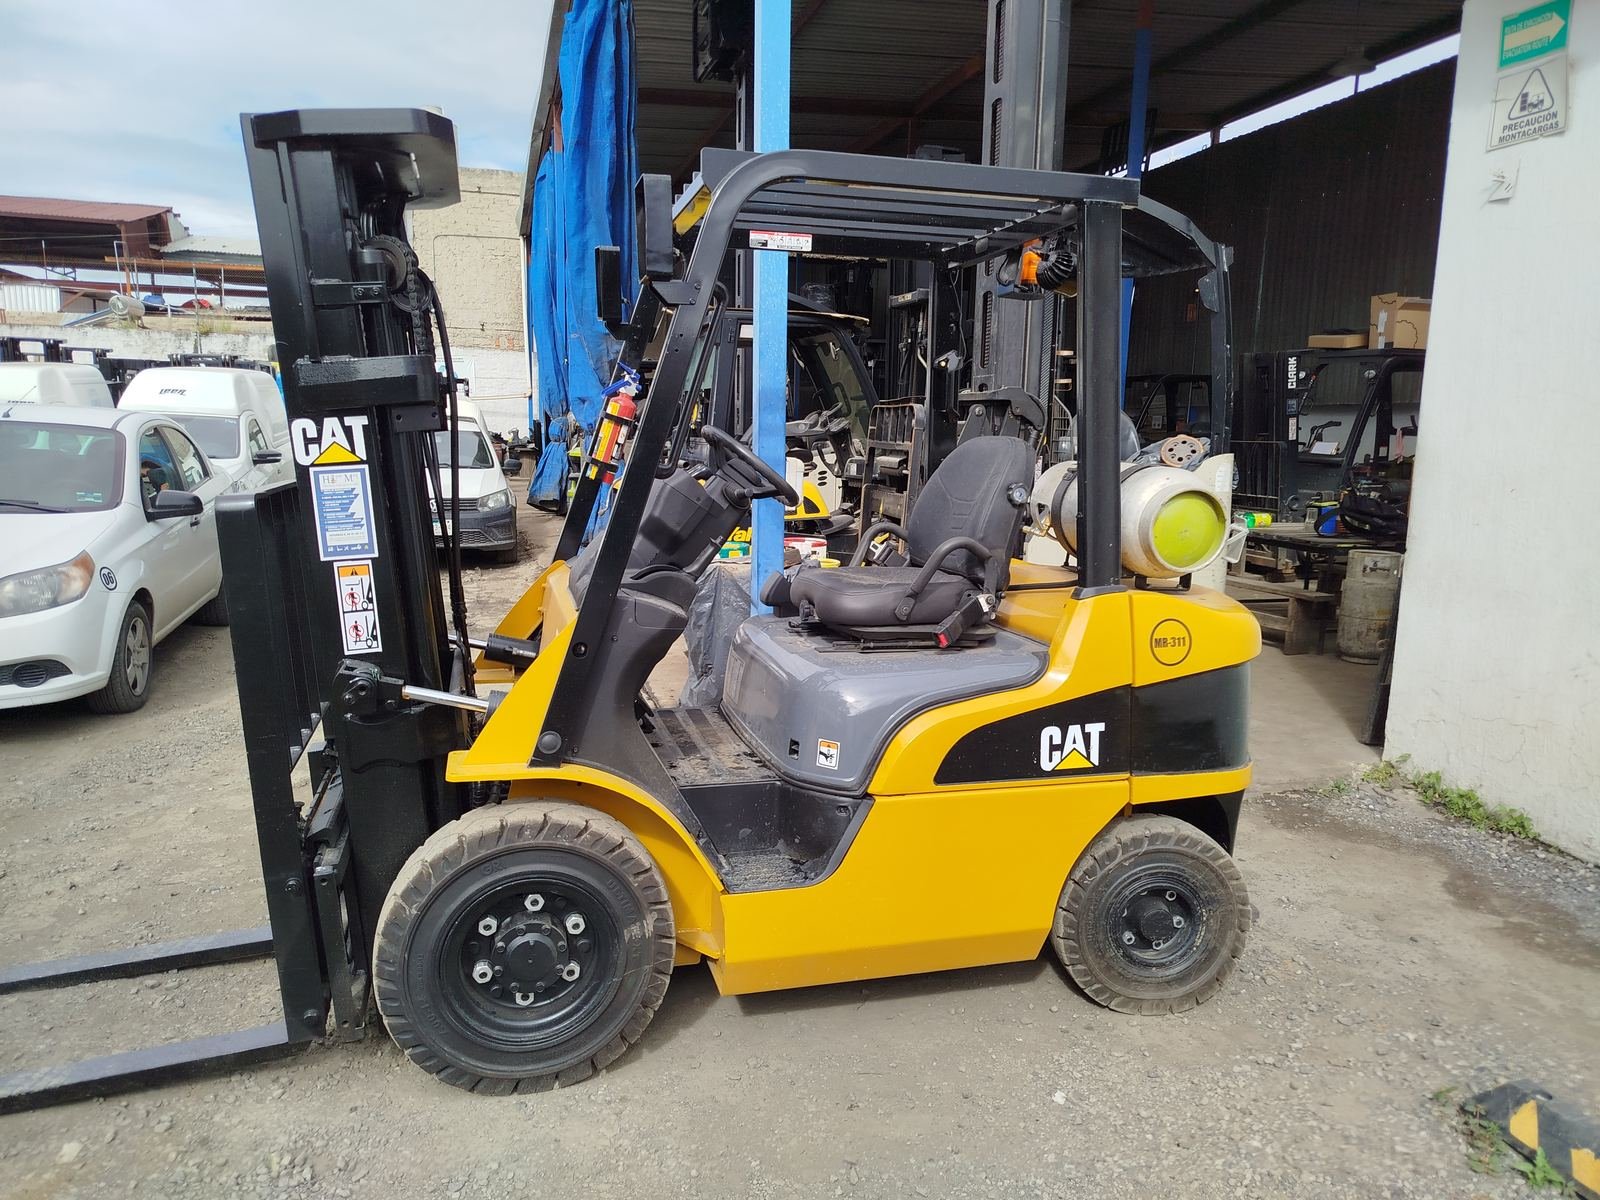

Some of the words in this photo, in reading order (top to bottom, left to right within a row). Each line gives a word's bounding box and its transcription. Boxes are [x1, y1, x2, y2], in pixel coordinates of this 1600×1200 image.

[1498, 120, 1559, 143] MONTACARGAS
[1288, 357, 1297, 389] CLARK
[291, 415, 369, 466] CAT
[102, 571, 115, 586] 06
[1040, 722, 1106, 772] CAT
